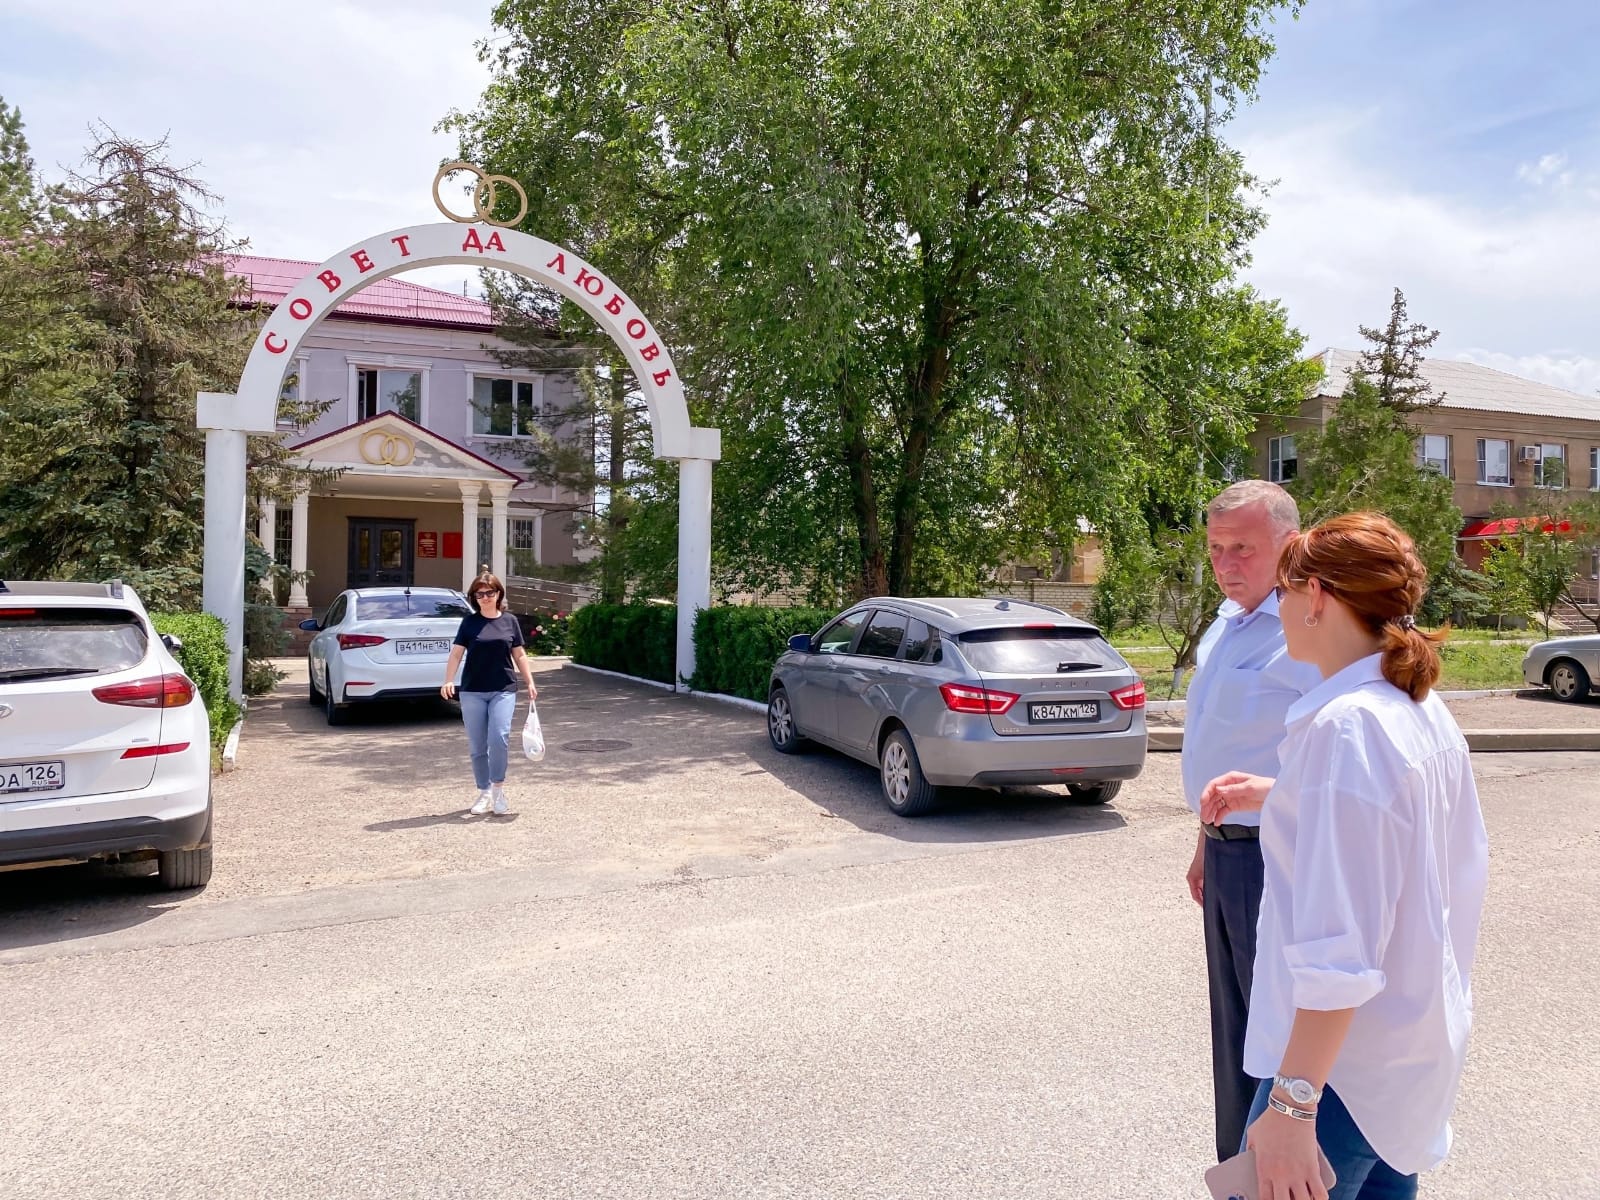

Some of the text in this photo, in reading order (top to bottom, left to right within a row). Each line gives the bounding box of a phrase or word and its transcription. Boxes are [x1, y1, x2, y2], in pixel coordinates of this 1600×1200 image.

[265, 228, 672, 387] СОВЕТ ДА ЛЮБОВЬ
[1079, 704, 1096, 714] 126
[25, 765, 57, 780] 126
